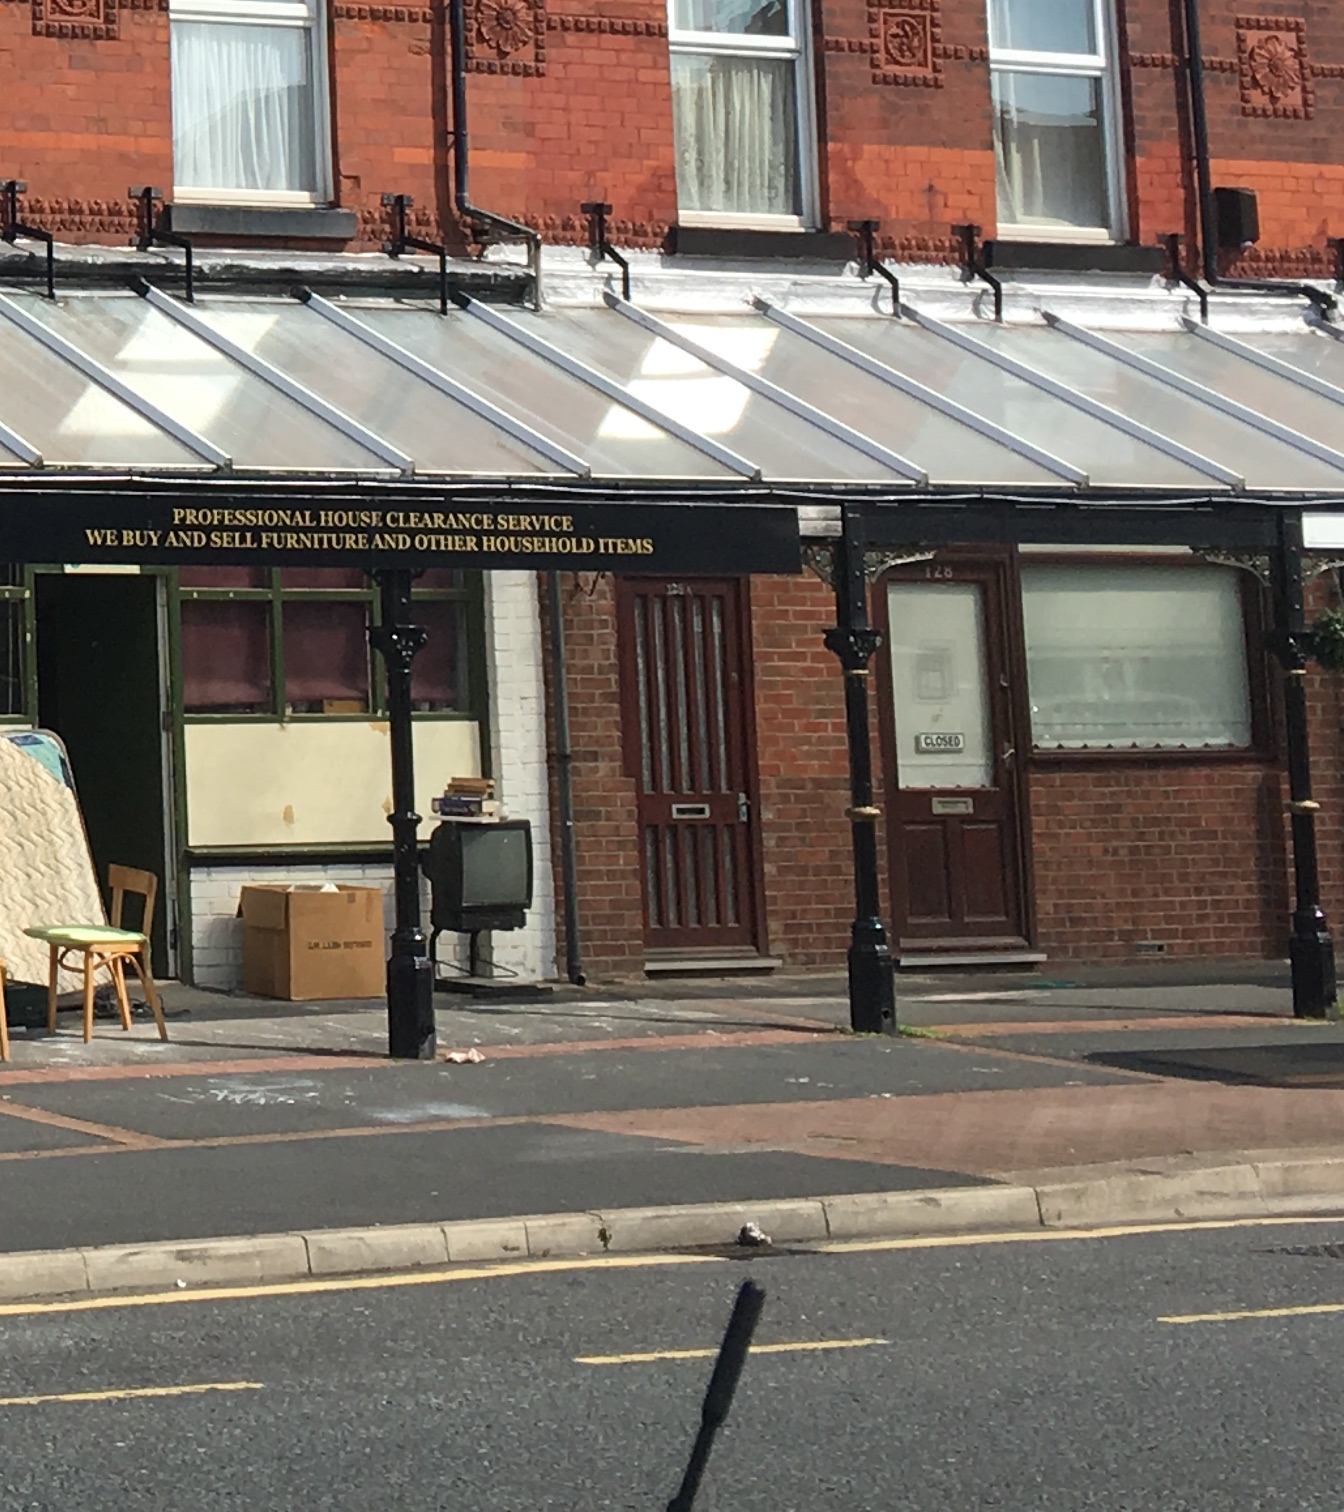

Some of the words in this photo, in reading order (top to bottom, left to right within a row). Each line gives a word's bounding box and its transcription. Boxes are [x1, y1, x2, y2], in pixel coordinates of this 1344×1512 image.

[172, 508, 317, 527] PROFESSIONAL
[319, 510, 382, 528] HOUSE
[386, 511, 494, 530] CLEARANCE
[497, 514, 574, 531] SERVICE
[85, 529, 118, 546] WE
[122, 529, 161, 547] BUY
[164, 530, 207, 548] AND
[210, 531, 257, 548] SELL
[261, 532, 367, 549] FURNITURE
[370, 533, 411, 550] AND
[414, 535, 479, 551] OTHER
[482, 536, 595, 554] HOUSEHOLD
[599, 538, 654, 554] ITEMS
[924, 735, 961, 748] CLOSED
